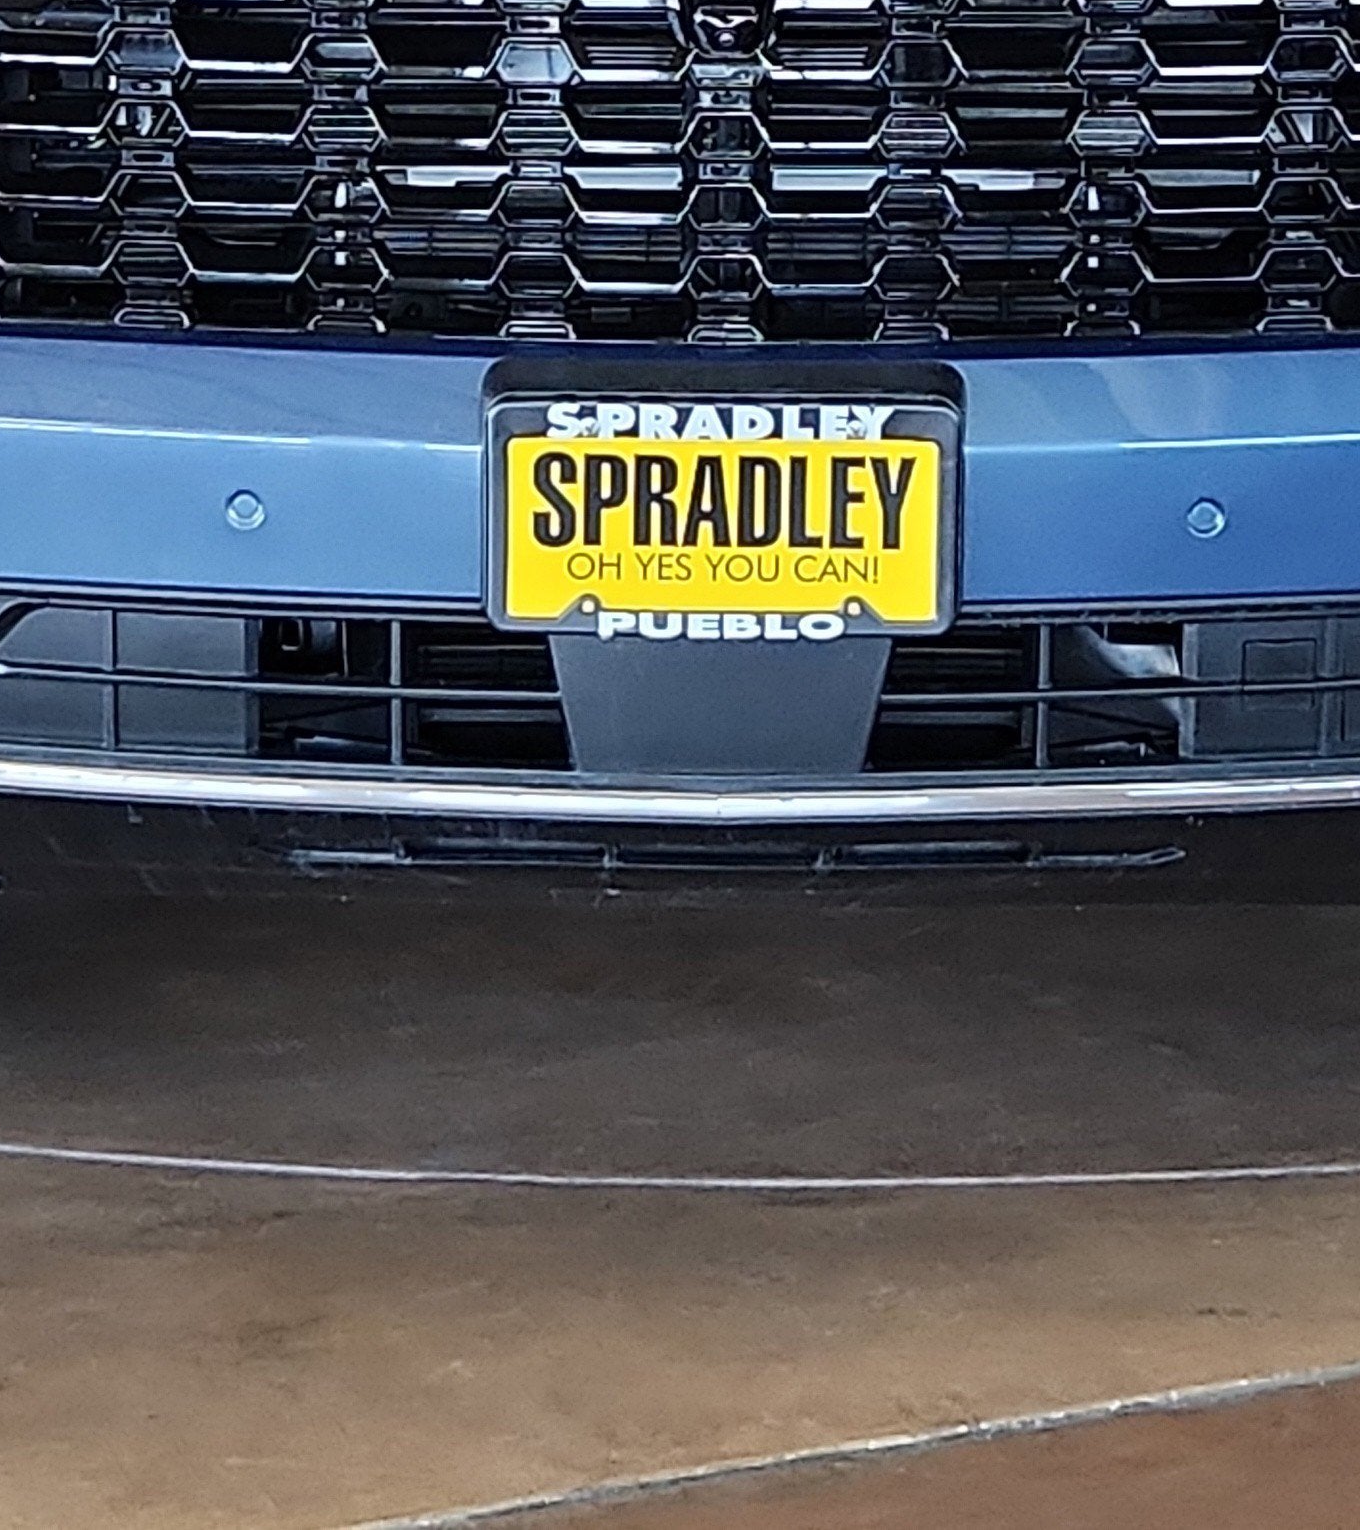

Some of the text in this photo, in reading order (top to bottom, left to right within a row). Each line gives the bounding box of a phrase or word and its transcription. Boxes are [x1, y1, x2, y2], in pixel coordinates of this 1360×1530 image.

[545, 402, 894, 441] SPRADLEY
[532, 451, 917, 550] SPRADLEY
[566, 552, 880, 585] OH YES YOU CAN!
[596, 611, 846, 642] PUEBLO
